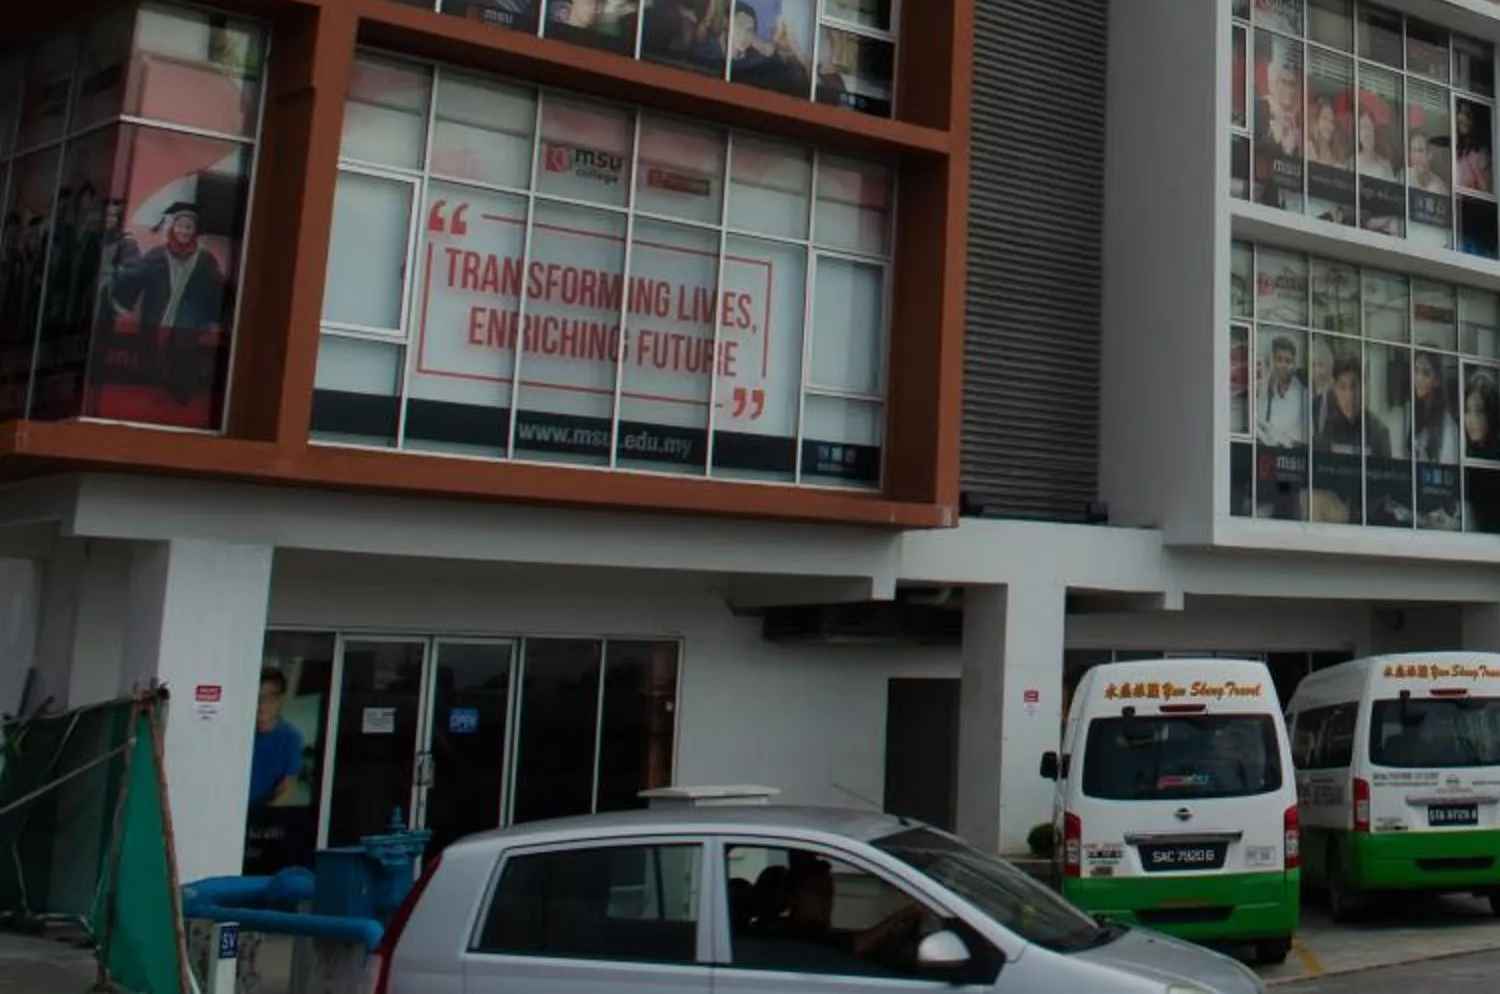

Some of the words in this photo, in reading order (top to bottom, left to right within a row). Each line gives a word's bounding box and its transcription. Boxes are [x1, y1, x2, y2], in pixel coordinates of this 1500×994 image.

[575, 148, 623, 171] msu
[445, 247, 671, 318] TRANSFORMING
[677, 283, 757, 334] LIVES,
[468, 306, 629, 363] ENRICHING
[637, 328, 739, 377] FUTURE
[1225, 681, 1262, 697] Travel
